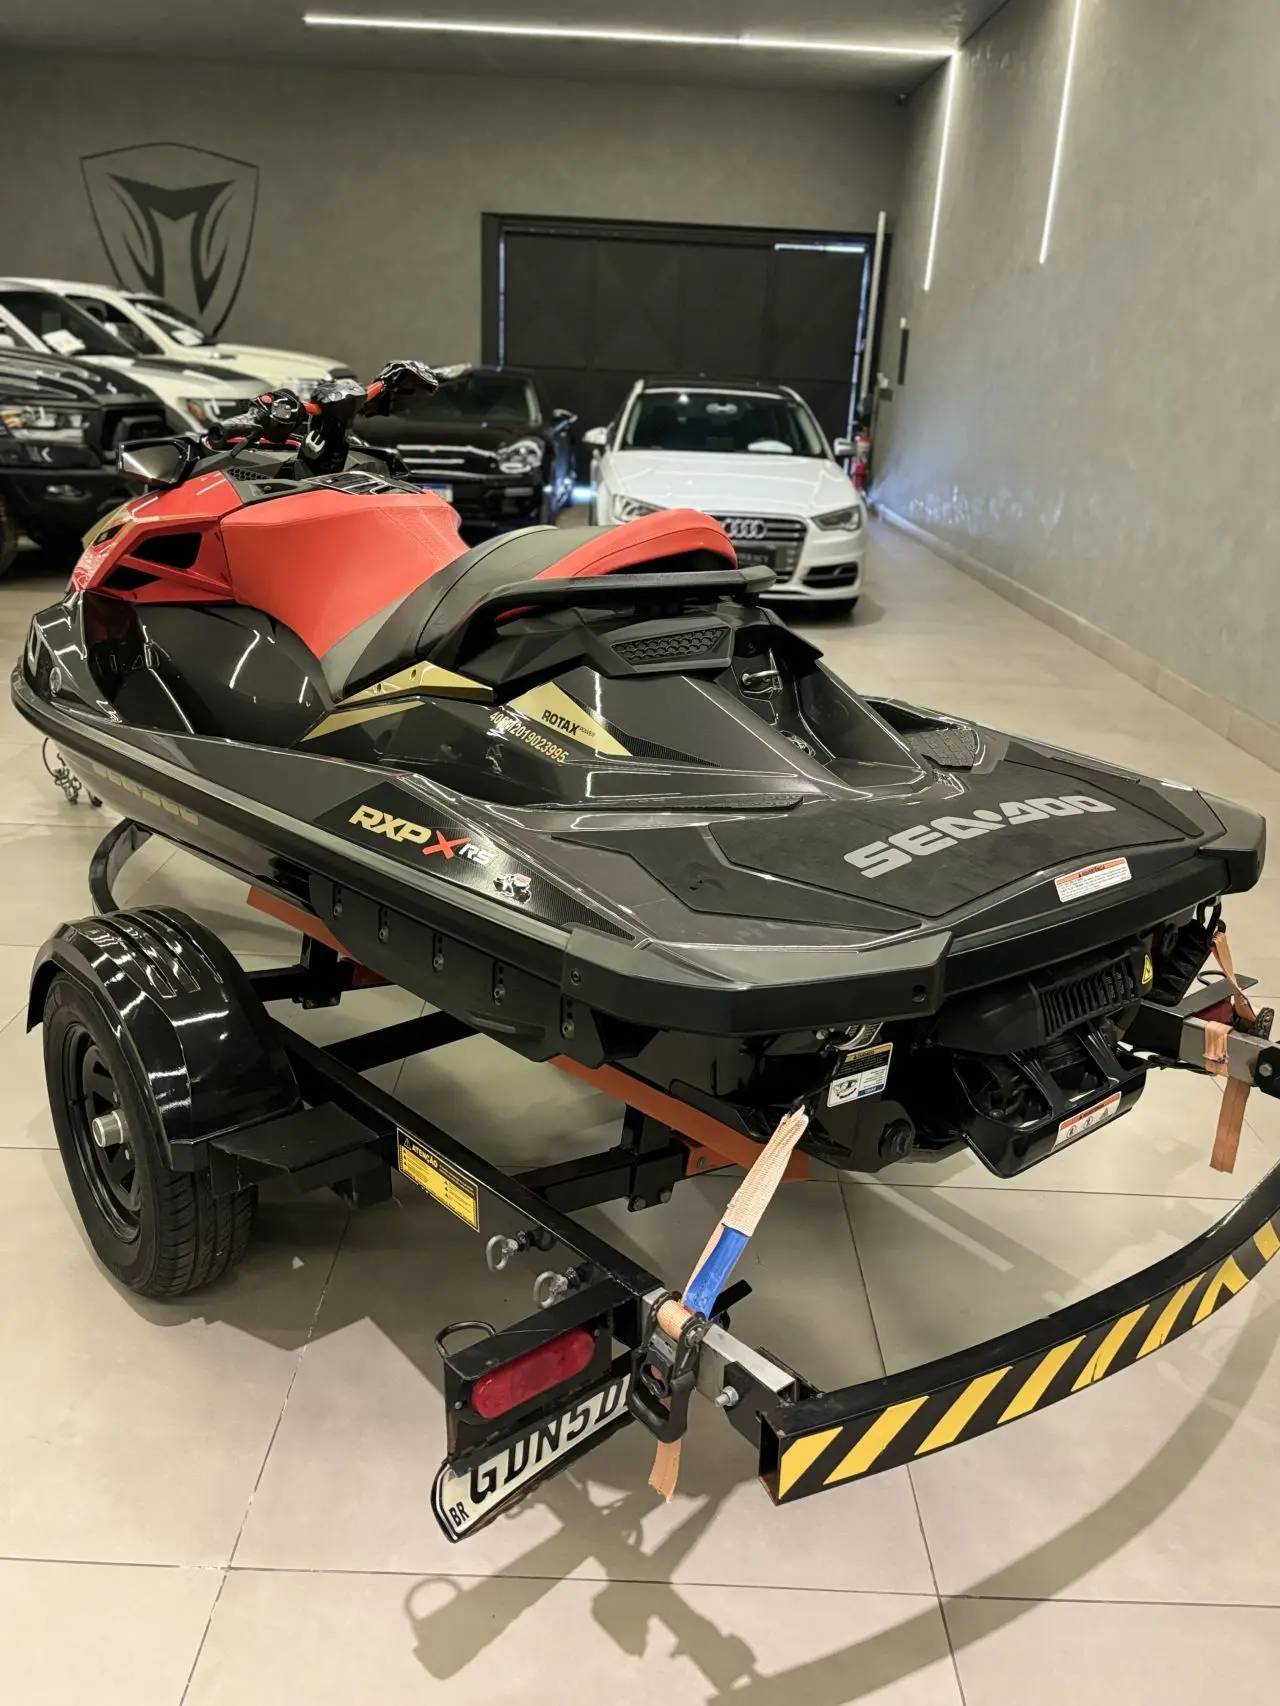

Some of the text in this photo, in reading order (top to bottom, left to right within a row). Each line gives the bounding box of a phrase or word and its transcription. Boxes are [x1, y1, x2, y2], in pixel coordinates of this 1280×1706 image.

[541, 709, 580, 736] ROTAX
[348, 804, 432, 844] RXP
[458, 843, 496, 867] RS
[411, 1143, 439, 1168] ATENÇÃO
[449, 1501, 470, 1528] BR
